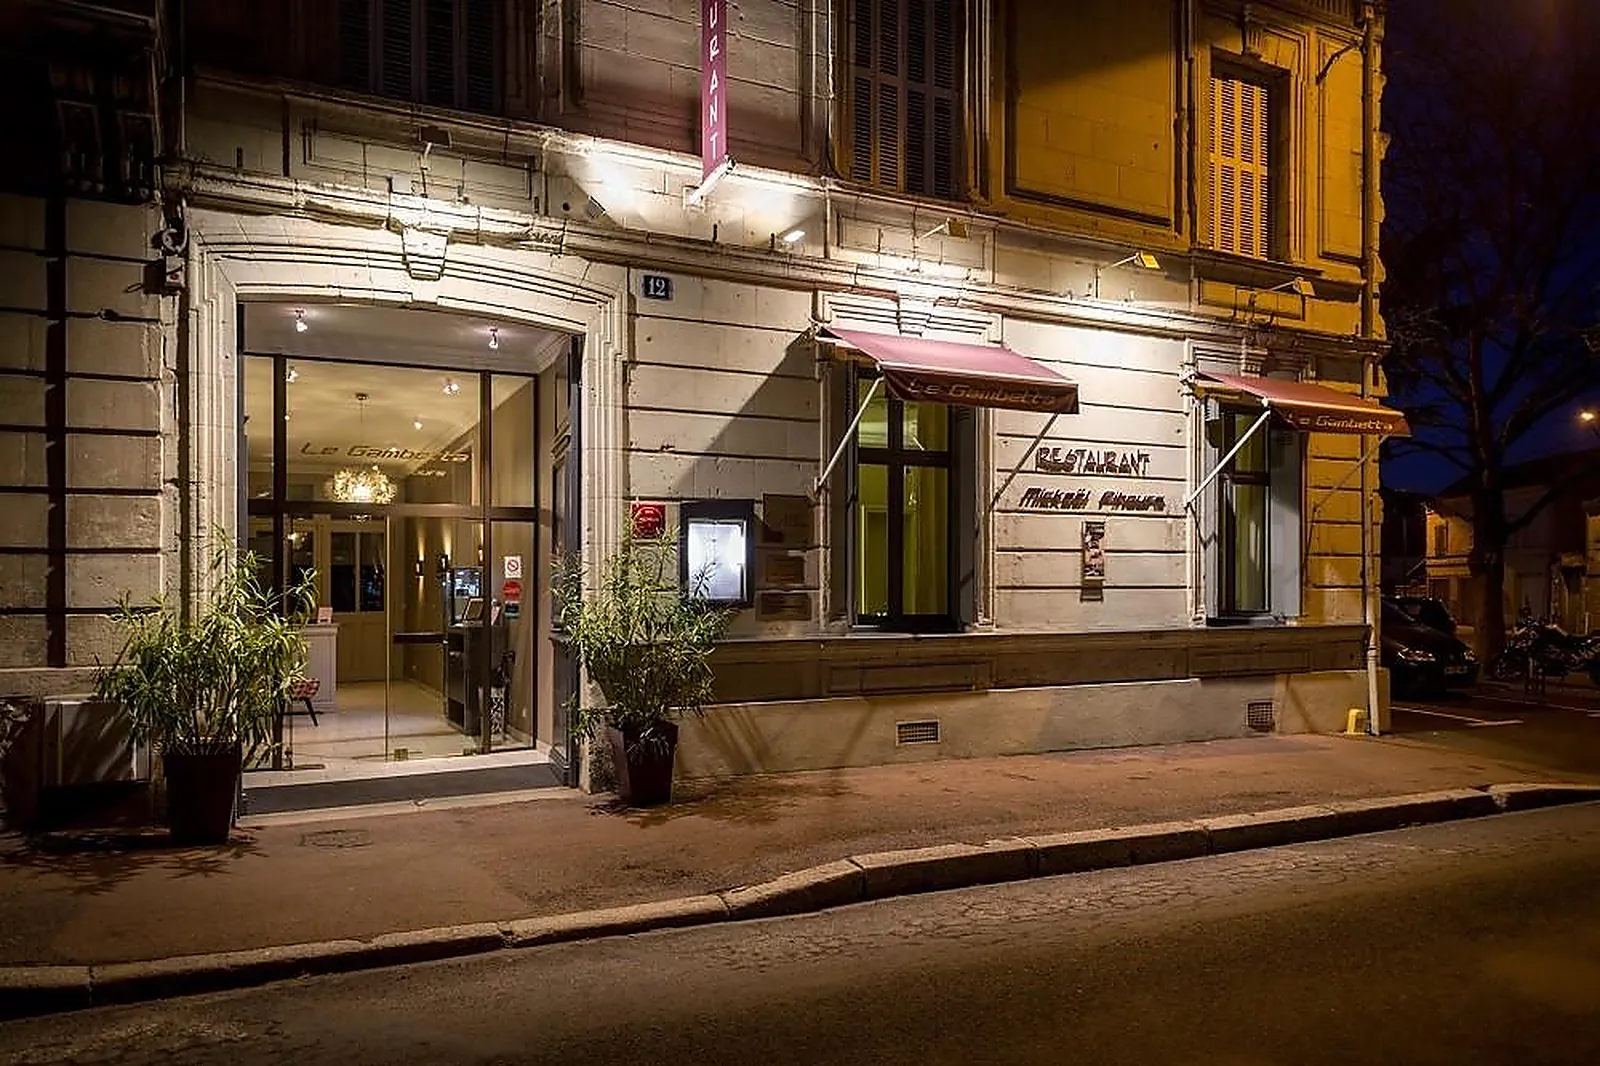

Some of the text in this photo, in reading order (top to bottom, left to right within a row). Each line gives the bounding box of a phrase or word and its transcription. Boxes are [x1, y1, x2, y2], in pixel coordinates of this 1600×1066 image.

[648, 277, 666, 296] 12
[907, 380, 1056, 406] Le Gambetta
[1315, 414, 1394, 431] Gambetta
[300, 442, 471, 463] Le Gambeta
[1036, 447, 1151, 475] RESTAURANT
